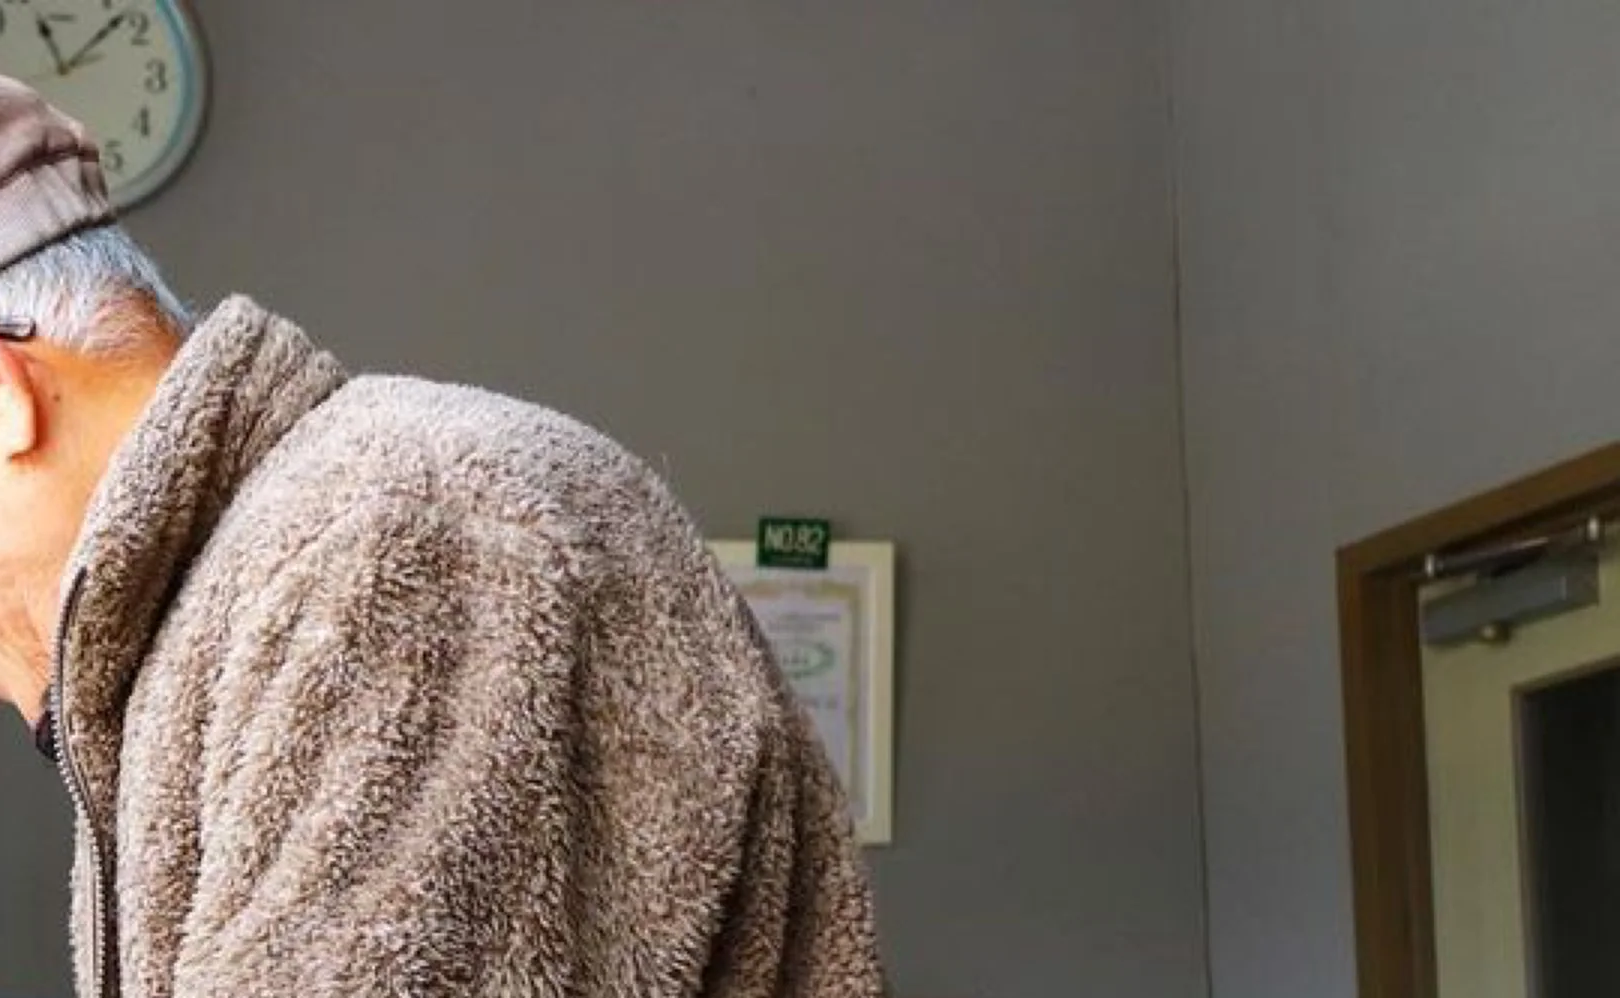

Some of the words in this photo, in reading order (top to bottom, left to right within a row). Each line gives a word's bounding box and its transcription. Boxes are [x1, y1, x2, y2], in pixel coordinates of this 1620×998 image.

[131, 13, 151, 46] 2
[145, 59, 167, 92] 3
[133, 107, 150, 137] 4
[104, 140, 124, 172] 5
